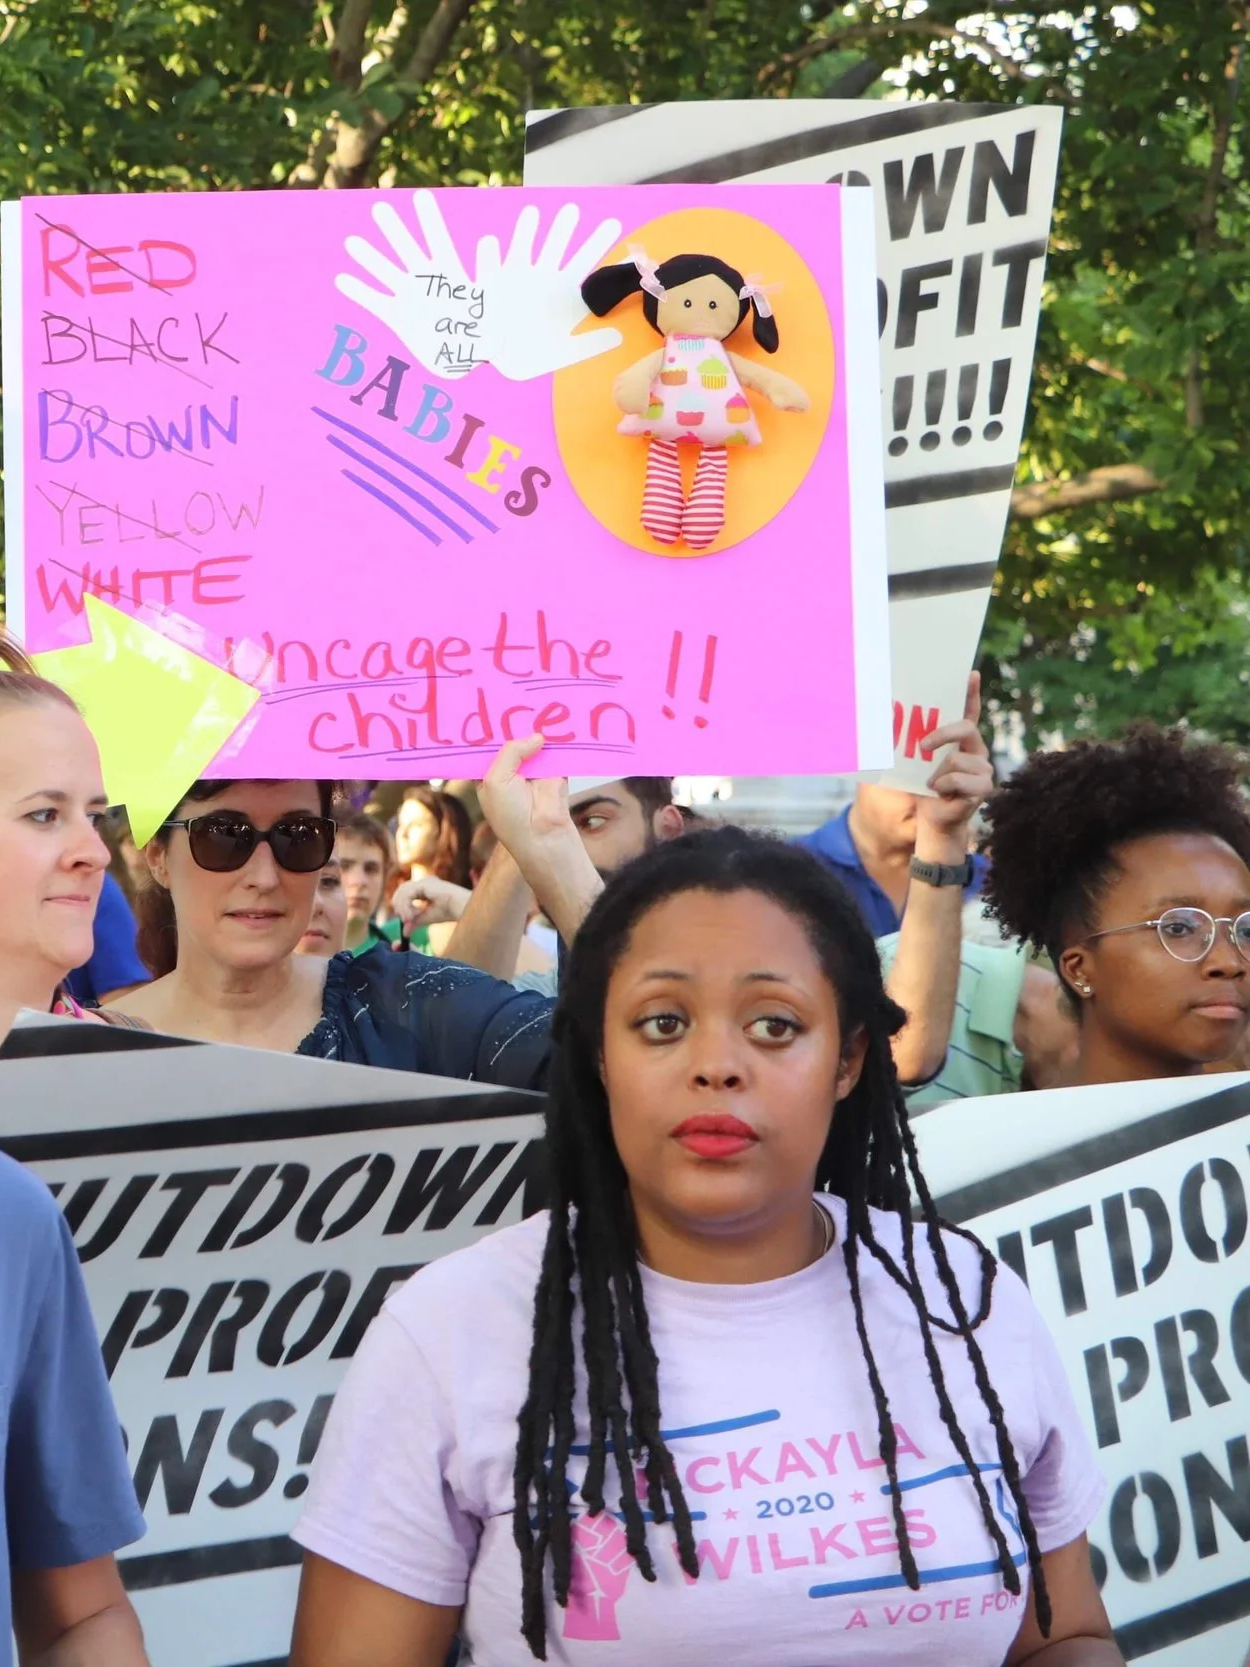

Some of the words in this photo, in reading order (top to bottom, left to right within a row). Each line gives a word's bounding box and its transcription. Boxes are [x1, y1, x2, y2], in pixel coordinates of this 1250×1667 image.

[823, 130, 1037, 242] WN
[38, 223, 197, 298] RED
[877, 237, 1048, 350] FIT
[415, 273, 484, 319] They
[435, 317, 481, 338] are
[42, 311, 241, 366] BLACK
[434, 341, 489, 366] ALL
[37, 388, 239, 464] BROWN
[314, 323, 552, 518] BABIES
[36, 484, 265, 546] YELLOW
[36, 555, 253, 616] WHITE
[482, 611, 623, 680] the
[308, 687, 636, 753] children
[636, 1423, 926, 1501] CKAYLA
[756, 1491, 835, 1519] 2020
[672, 1508, 938, 1586] WILKES
[845, 1609, 869, 1631] A
[883, 1597, 971, 1625] VOTE
